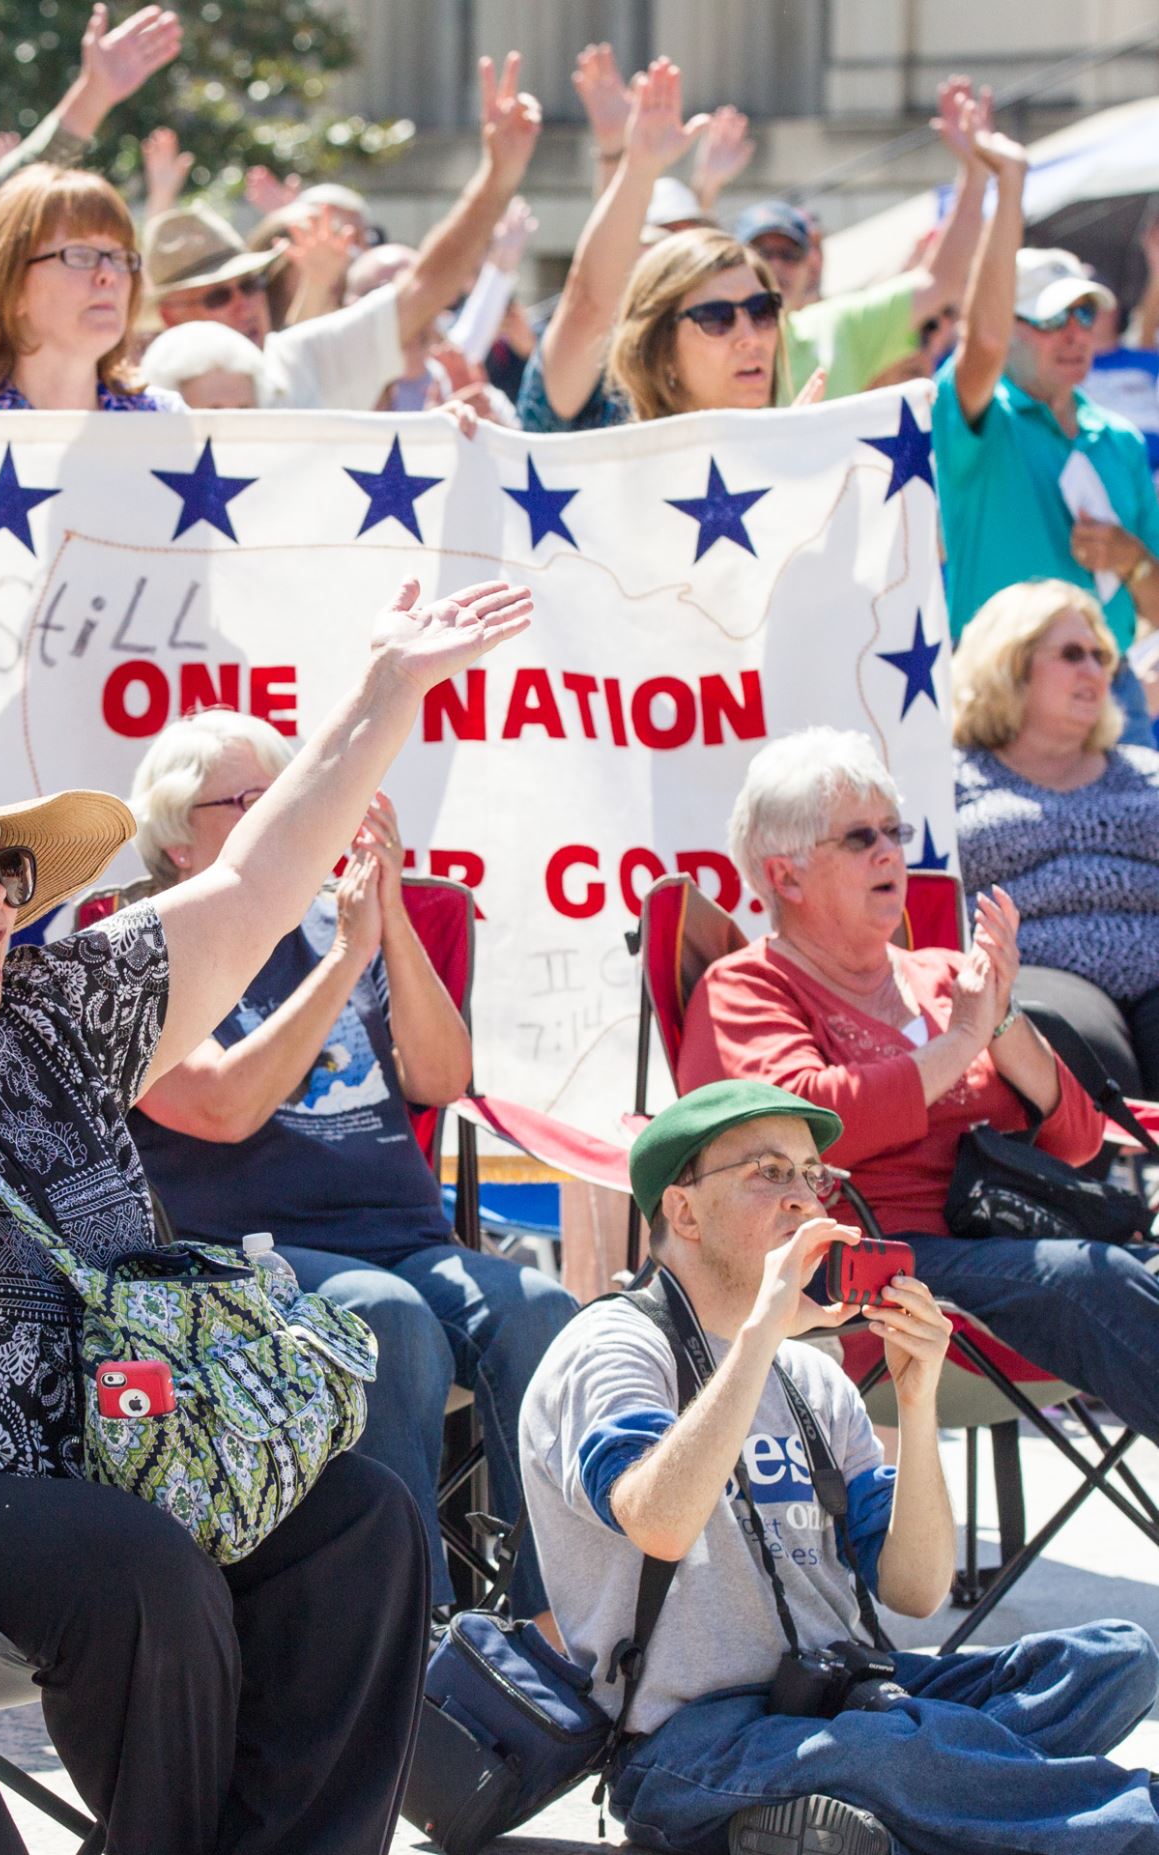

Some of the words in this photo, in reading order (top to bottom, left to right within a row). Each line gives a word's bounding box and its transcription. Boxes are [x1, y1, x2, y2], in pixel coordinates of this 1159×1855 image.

[102, 659, 298, 738] ONE
[423, 668, 767, 749] NATION
[517, 994, 603, 1060] 7:14
